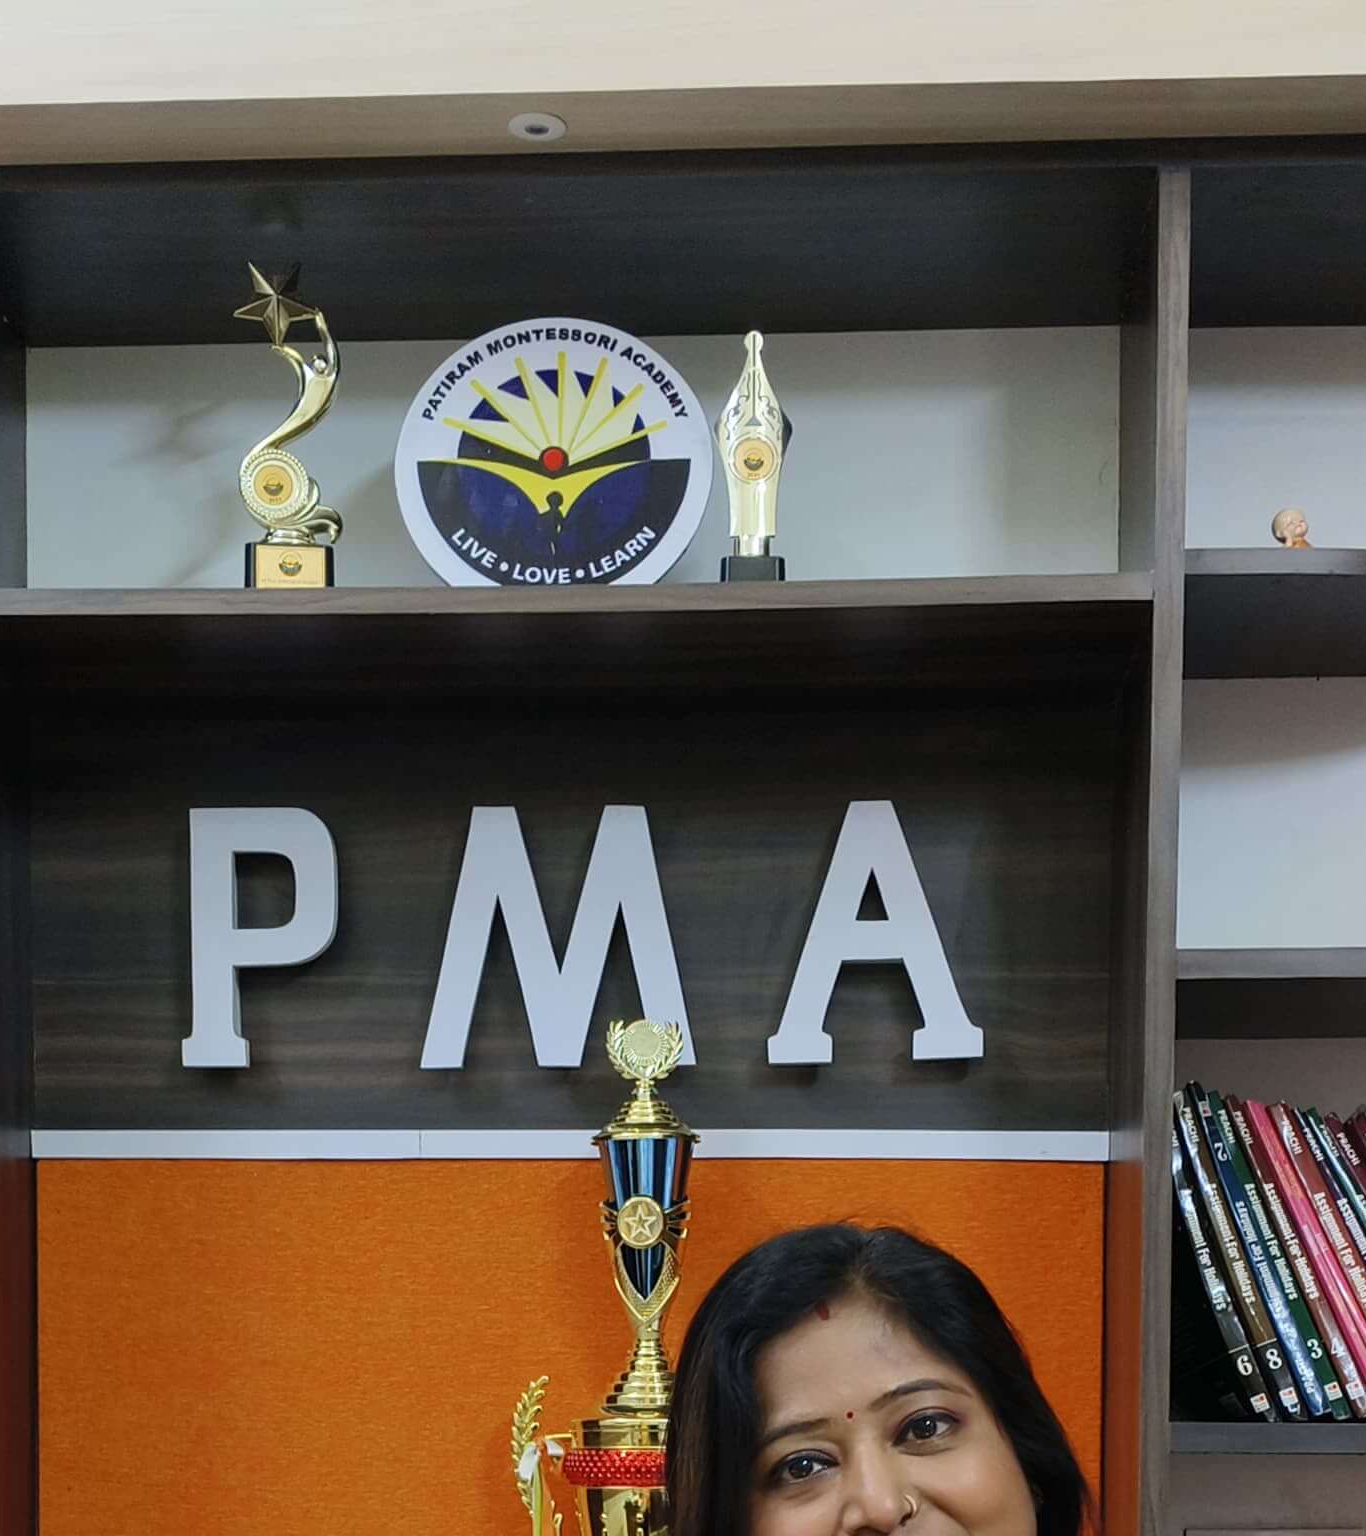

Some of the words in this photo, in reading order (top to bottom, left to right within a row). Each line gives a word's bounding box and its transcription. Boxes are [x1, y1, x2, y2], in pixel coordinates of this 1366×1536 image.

[422, 350, 483, 420] PATIRAM
[486, 328, 618, 356] MONTESSORI
[619, 346, 688, 417] ACADEMY
[451, 528, 495, 569] LIVE
[512, 562, 571, 584] LOVE
[589, 526, 656, 579] LEARN
[1234, 1110, 1254, 1145] PRACHI
[1337, 1131, 1361, 1166] PRACHI
[1214, 1142, 1227, 1161] 2
[1263, 1182, 1296, 1241] Assignment
[1281, 1119, 1303, 1155] PRACHI
[1314, 1191, 1349, 1250] Assignment
[1339, 1247, 1356, 1268] For
[1217, 1108, 1236, 1144] PRACHI
[1244, 1183, 1275, 1240] Assignment
[1266, 1239, 1281, 1258] For
[1274, 1257, 1299, 1301] Holidays
[1306, 1337, 1323, 1360] 3
[1226, 1240, 1240, 1260] For
[1286, 1239, 1303, 1260] For
[1232, 1260, 1256, 1304] Holidays
[1294, 1256, 1320, 1300] Holidays
[1197, 1248, 1212, 1267] For
[1236, 1354, 1253, 1376] 6
[1266, 1348, 1282, 1370] 8
